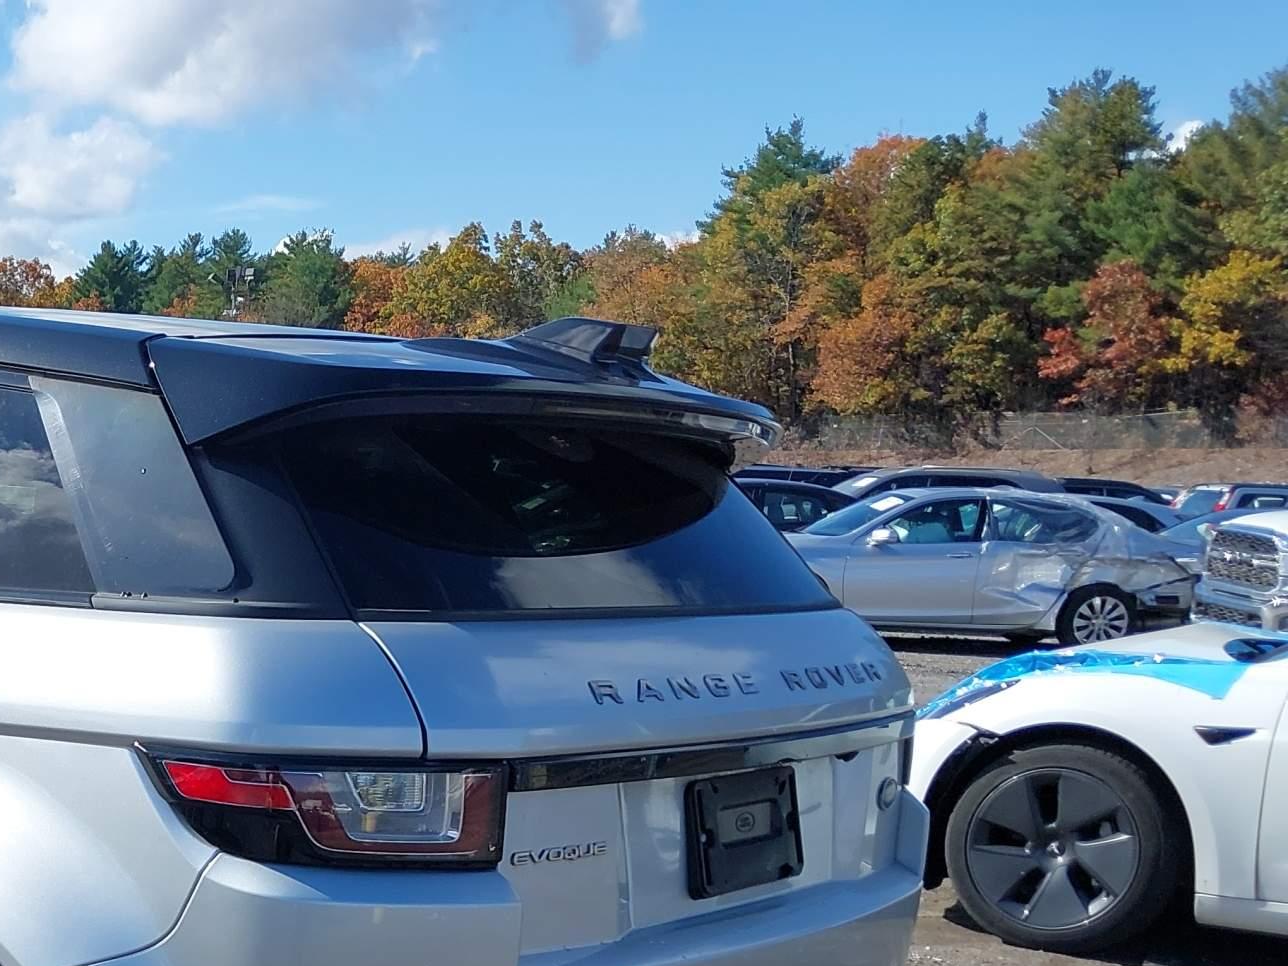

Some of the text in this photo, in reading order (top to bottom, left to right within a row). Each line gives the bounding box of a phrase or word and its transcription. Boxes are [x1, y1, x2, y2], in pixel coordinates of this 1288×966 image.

[588, 661, 883, 705] RANGE ROVER
[510, 840, 608, 867] EVOQUE
